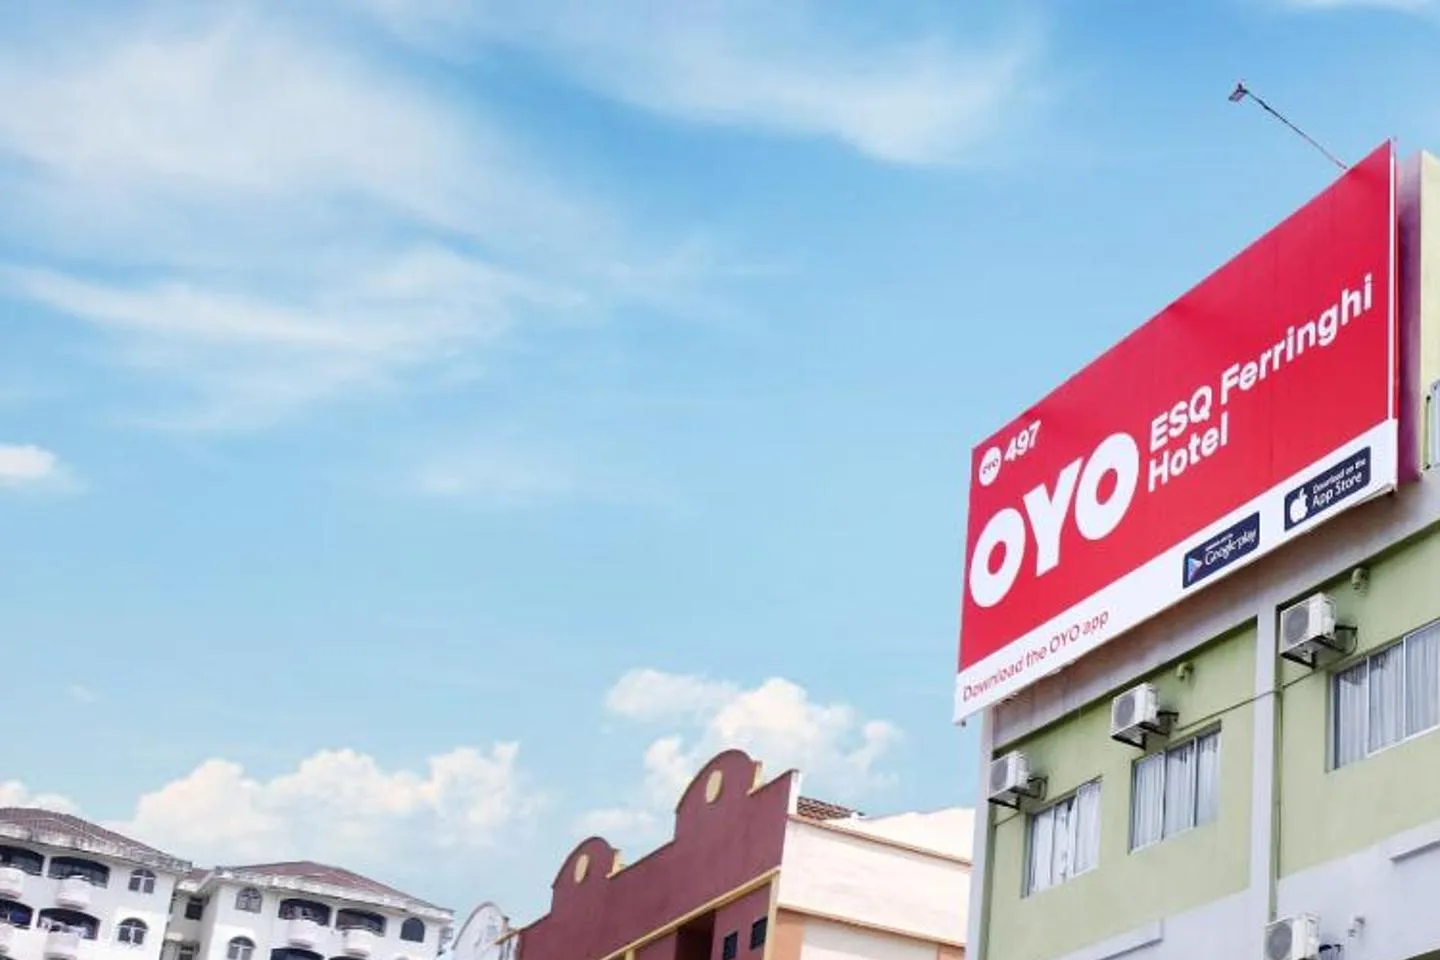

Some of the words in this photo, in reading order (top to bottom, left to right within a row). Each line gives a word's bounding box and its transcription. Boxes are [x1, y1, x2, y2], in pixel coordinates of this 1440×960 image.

[1150, 385, 1213, 453] ESQ
[1220, 272, 1373, 406] Ferringhi
[1004, 419, 1042, 462] 497
[1148, 411, 1229, 493] Hotel
[969, 432, 1139, 608] OYO
[1312, 491, 1333, 508] App
[1335, 472, 1363, 496] Store
[963, 657, 1024, 702] Download
[1026, 645, 1048, 668] the
[1049, 624, 1080, 654] OYO
[1083, 610, 1110, 637] app
